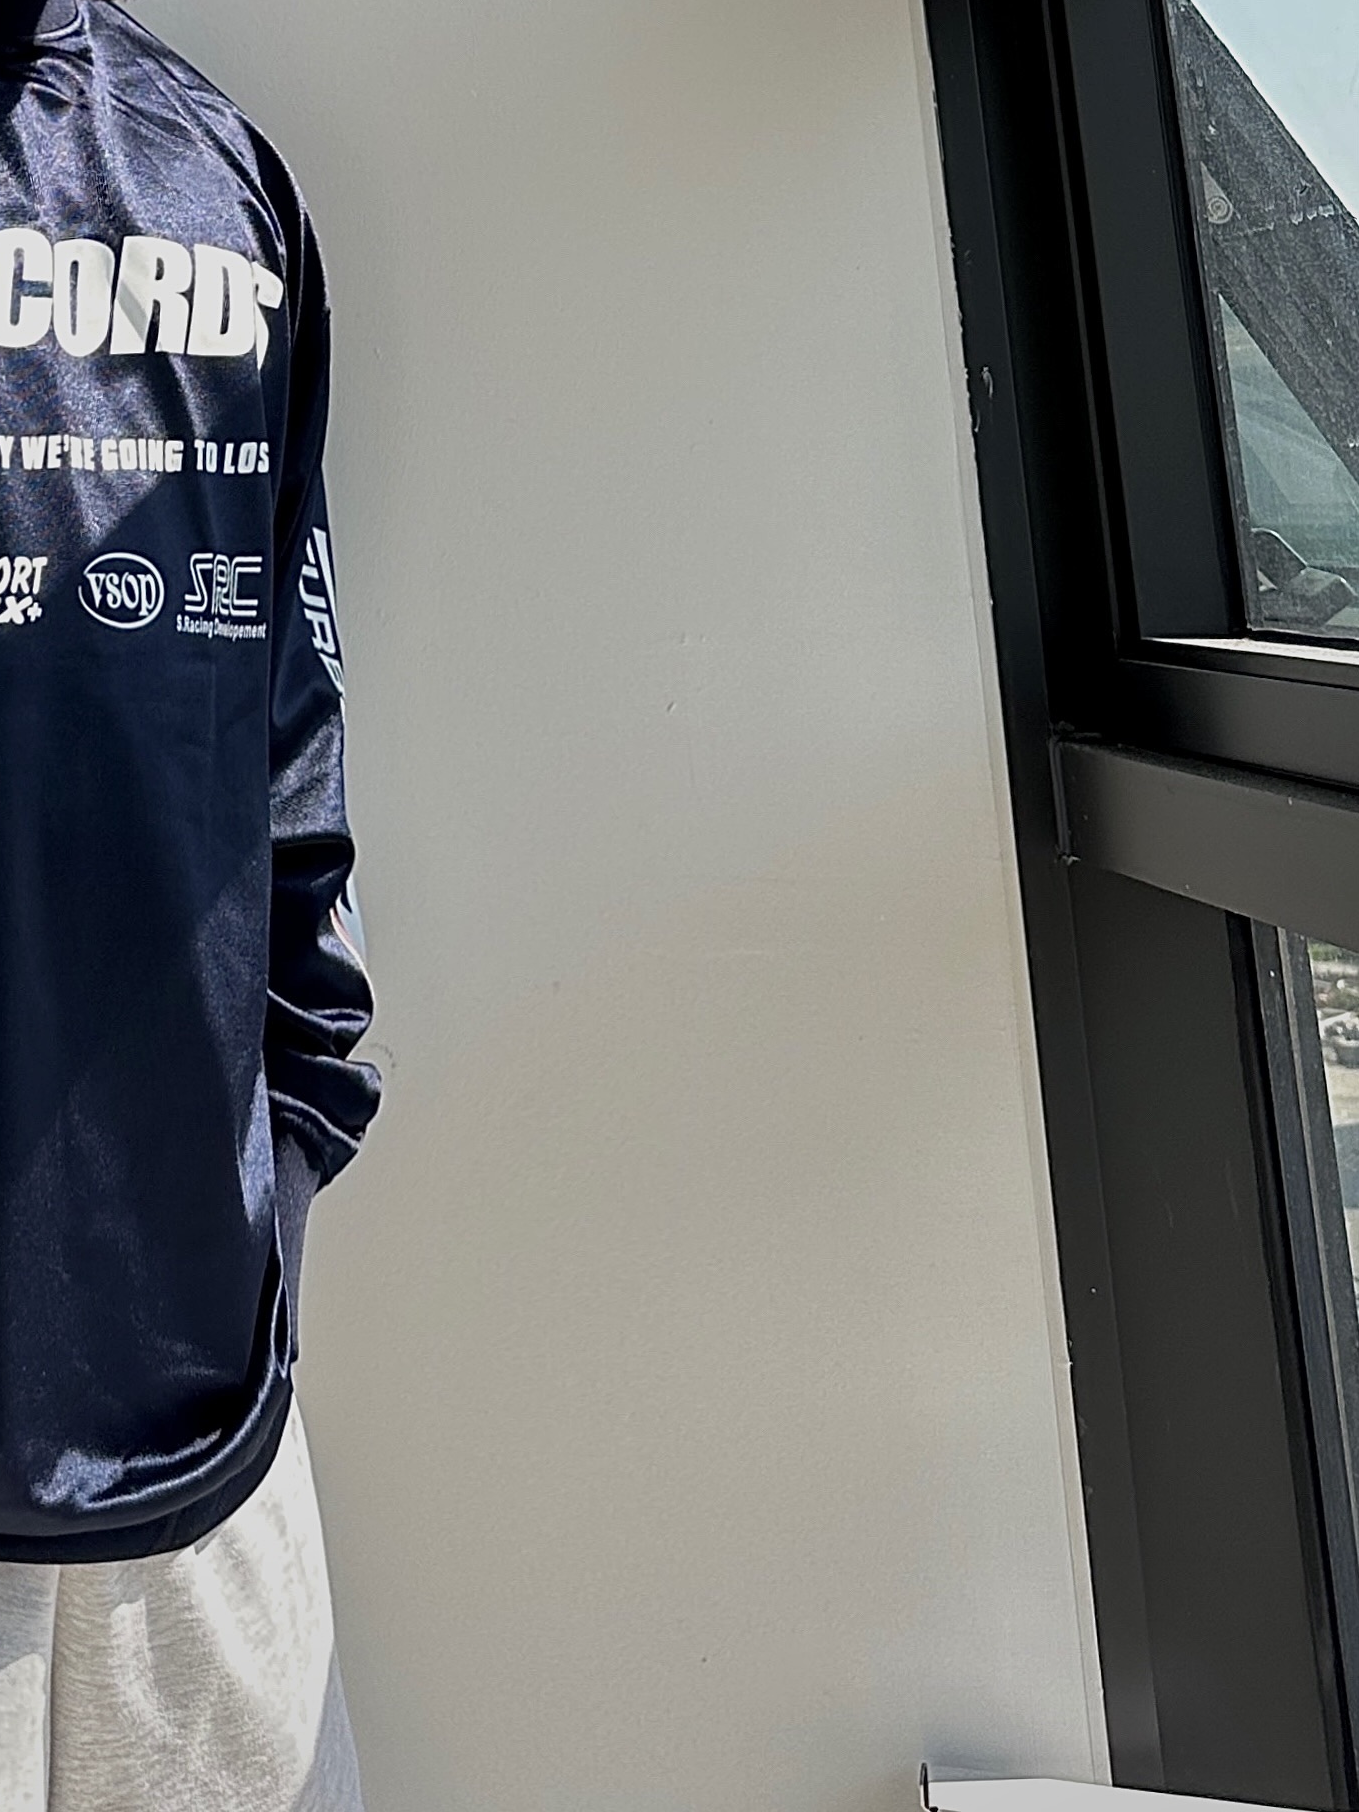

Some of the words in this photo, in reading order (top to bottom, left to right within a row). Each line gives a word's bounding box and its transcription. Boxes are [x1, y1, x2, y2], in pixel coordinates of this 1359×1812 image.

[21, 434, 95, 471] WE'RE
[101, 439, 183, 472] GOING
[194, 439, 217, 473] TO
[184, 553, 262, 617] SRC
